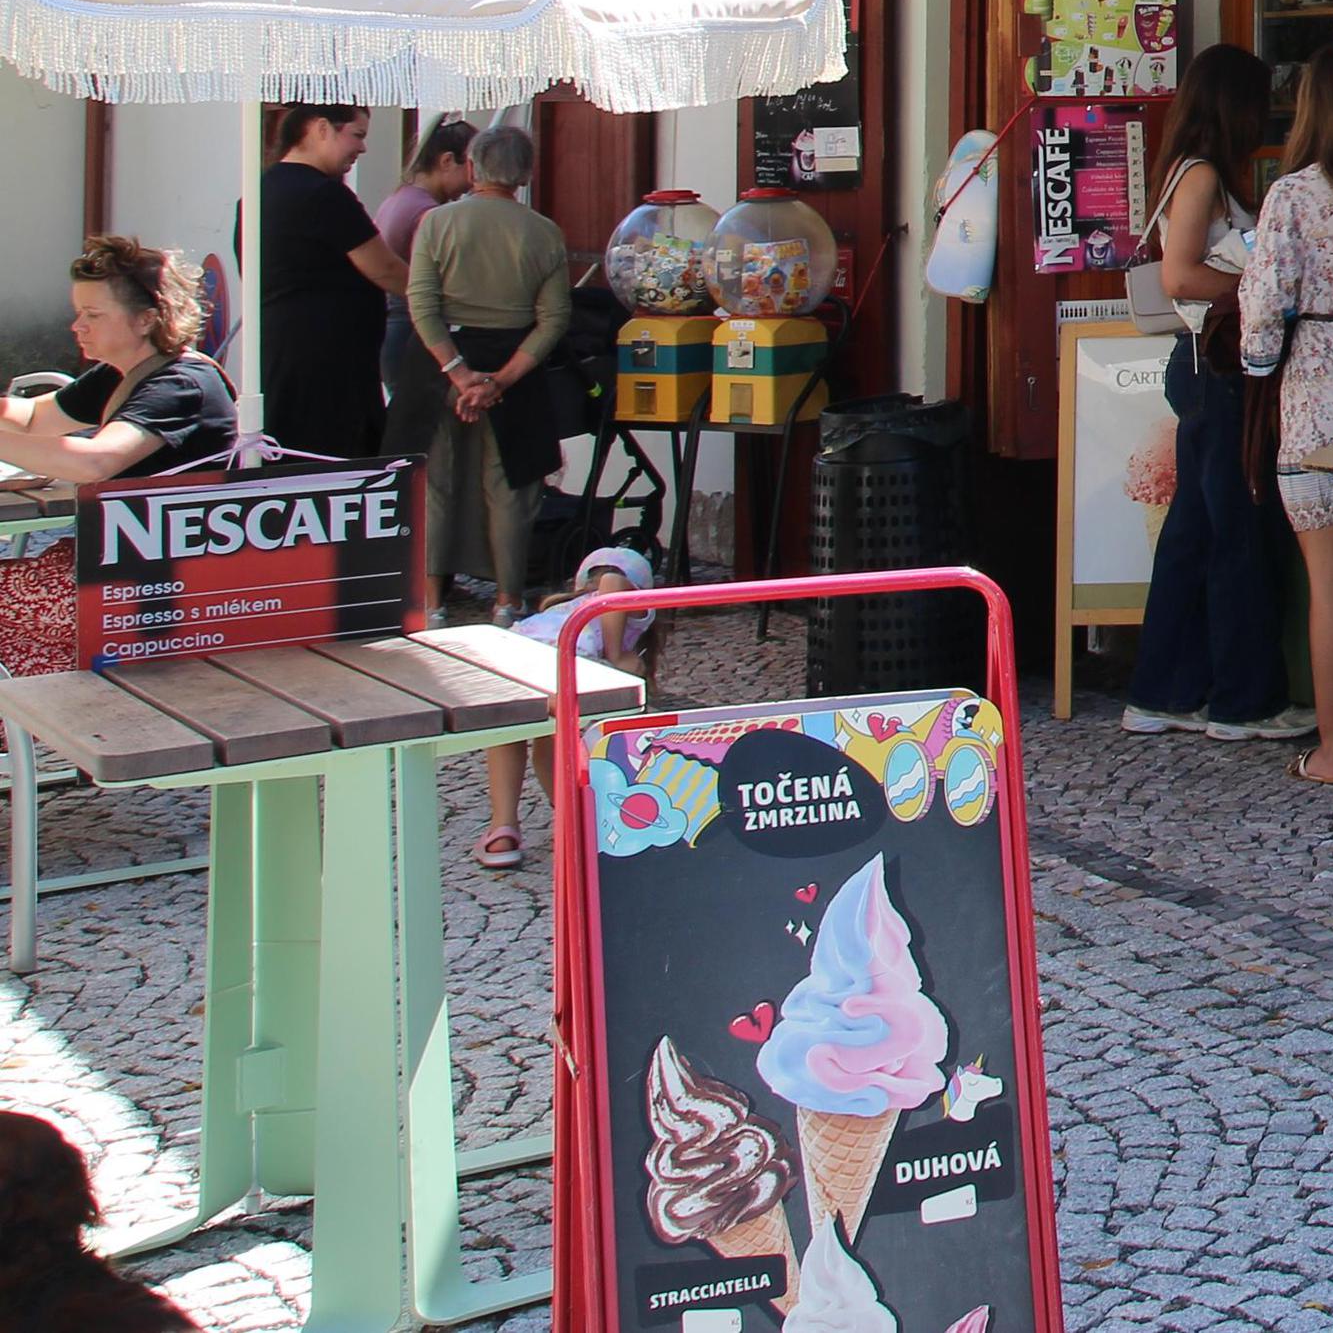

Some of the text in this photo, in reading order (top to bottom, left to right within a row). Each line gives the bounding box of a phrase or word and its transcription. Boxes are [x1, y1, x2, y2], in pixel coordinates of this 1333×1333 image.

[100, 471, 400, 565] NESCAFÉ
[103, 579, 185, 602] Espresso
[103, 596, 282, 631] Espresso s mlékem
[103, 632, 224, 658] Cappuccino
[738, 766, 853, 807] TOČENÁ
[744, 800, 861, 831] ZMRZLINA
[896, 1141, 1002, 1184] DUHOVÁ
[649, 1273, 772, 1309] STRACCIATELLA
